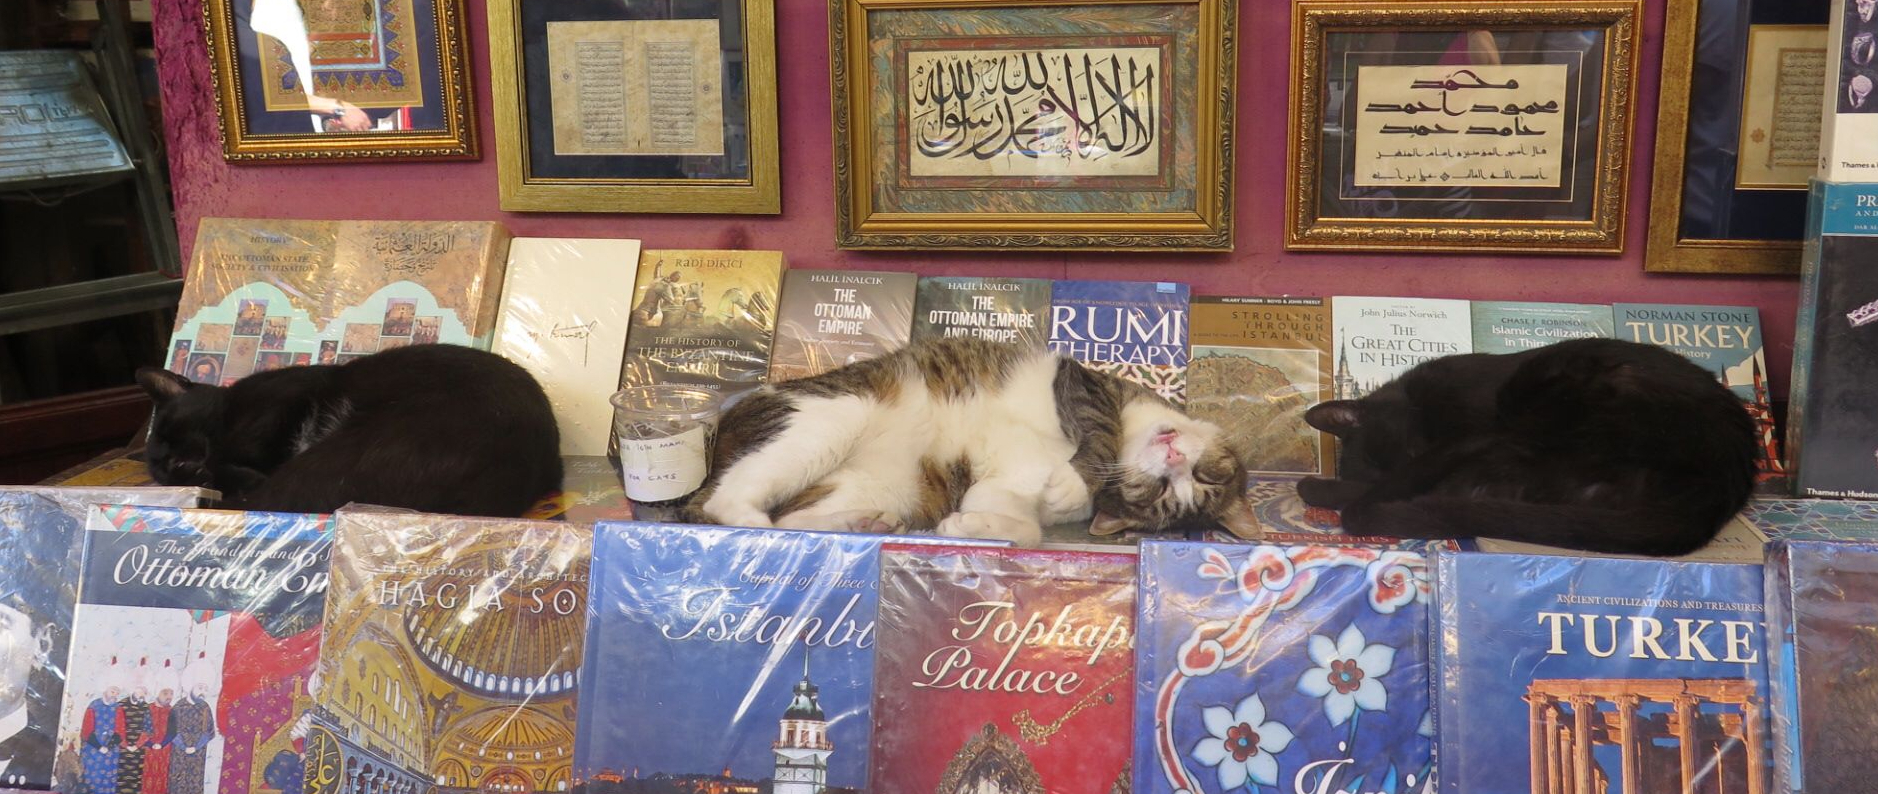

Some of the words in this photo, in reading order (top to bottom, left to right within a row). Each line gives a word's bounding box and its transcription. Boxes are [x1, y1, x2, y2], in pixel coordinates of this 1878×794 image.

[1841, 161, 1870, 169] Thames
[834, 288, 857, 303] THE
[972, 296, 995, 310] THE
[814, 303, 872, 320] OTTOMAN
[1232, 311, 1324, 321] STROLLING
[1360, 308, 1380, 318] John
[1382, 309, 1407, 318] Julius
[1409, 310, 1448, 319] Norwich
[1625, 309, 1696, 321] NORMAN
[1701, 311, 1752, 323] STONE
[929, 310, 987, 326] OTTOMAN
[989, 312, 1035, 328] EMPIRE
[1049, 305, 1184, 347] RUMI
[1501, 317, 1529, 325] CHASE
[1541, 318, 1587, 327] ROBINSON
[818, 319, 864, 335] EMPIRE
[943, 327, 968, 339] AND
[1246, 322, 1324, 332] THROUGH
[1492, 325, 1532, 335] Islamic
[1534, 327, 1600, 339] Civilization
[654, 336, 676, 344] THE
[677, 337, 724, 347] HISTORY
[726, 339, 741, 347] OF
[1242, 331, 1324, 342] ISTANBUL
[1625, 321, 1754, 349] TURKEY
[638, 347, 667, 358] THE
[670, 347, 754, 362] BYZANTINE
[1047, 340, 1183, 365] THERAPY
[1360, 352, 1375, 363] IN
[628, 473, 641, 482] FOR
[648, 472, 677, 482] CATS
[1806, 487, 1841, 497] Thames
[1269, 533, 1342, 543] TURKISH
[154, 539, 183, 555] The
[113, 543, 270, 590] Ottoman
[415, 566, 473, 578] HISTORY
[738, 570, 794, 591] Capital
[795, 573, 813, 592] of
[379, 580, 505, 613] HAGIA
[530, 587, 577, 616] SO
[1556, 593, 1601, 605] ANCIENT
[1602, 596, 1679, 609] CIVILIZATIONS
[1681, 600, 1702, 610] AND
[1704, 601, 1764, 613] TREASURES
[911, 645, 1085, 695] Palace
